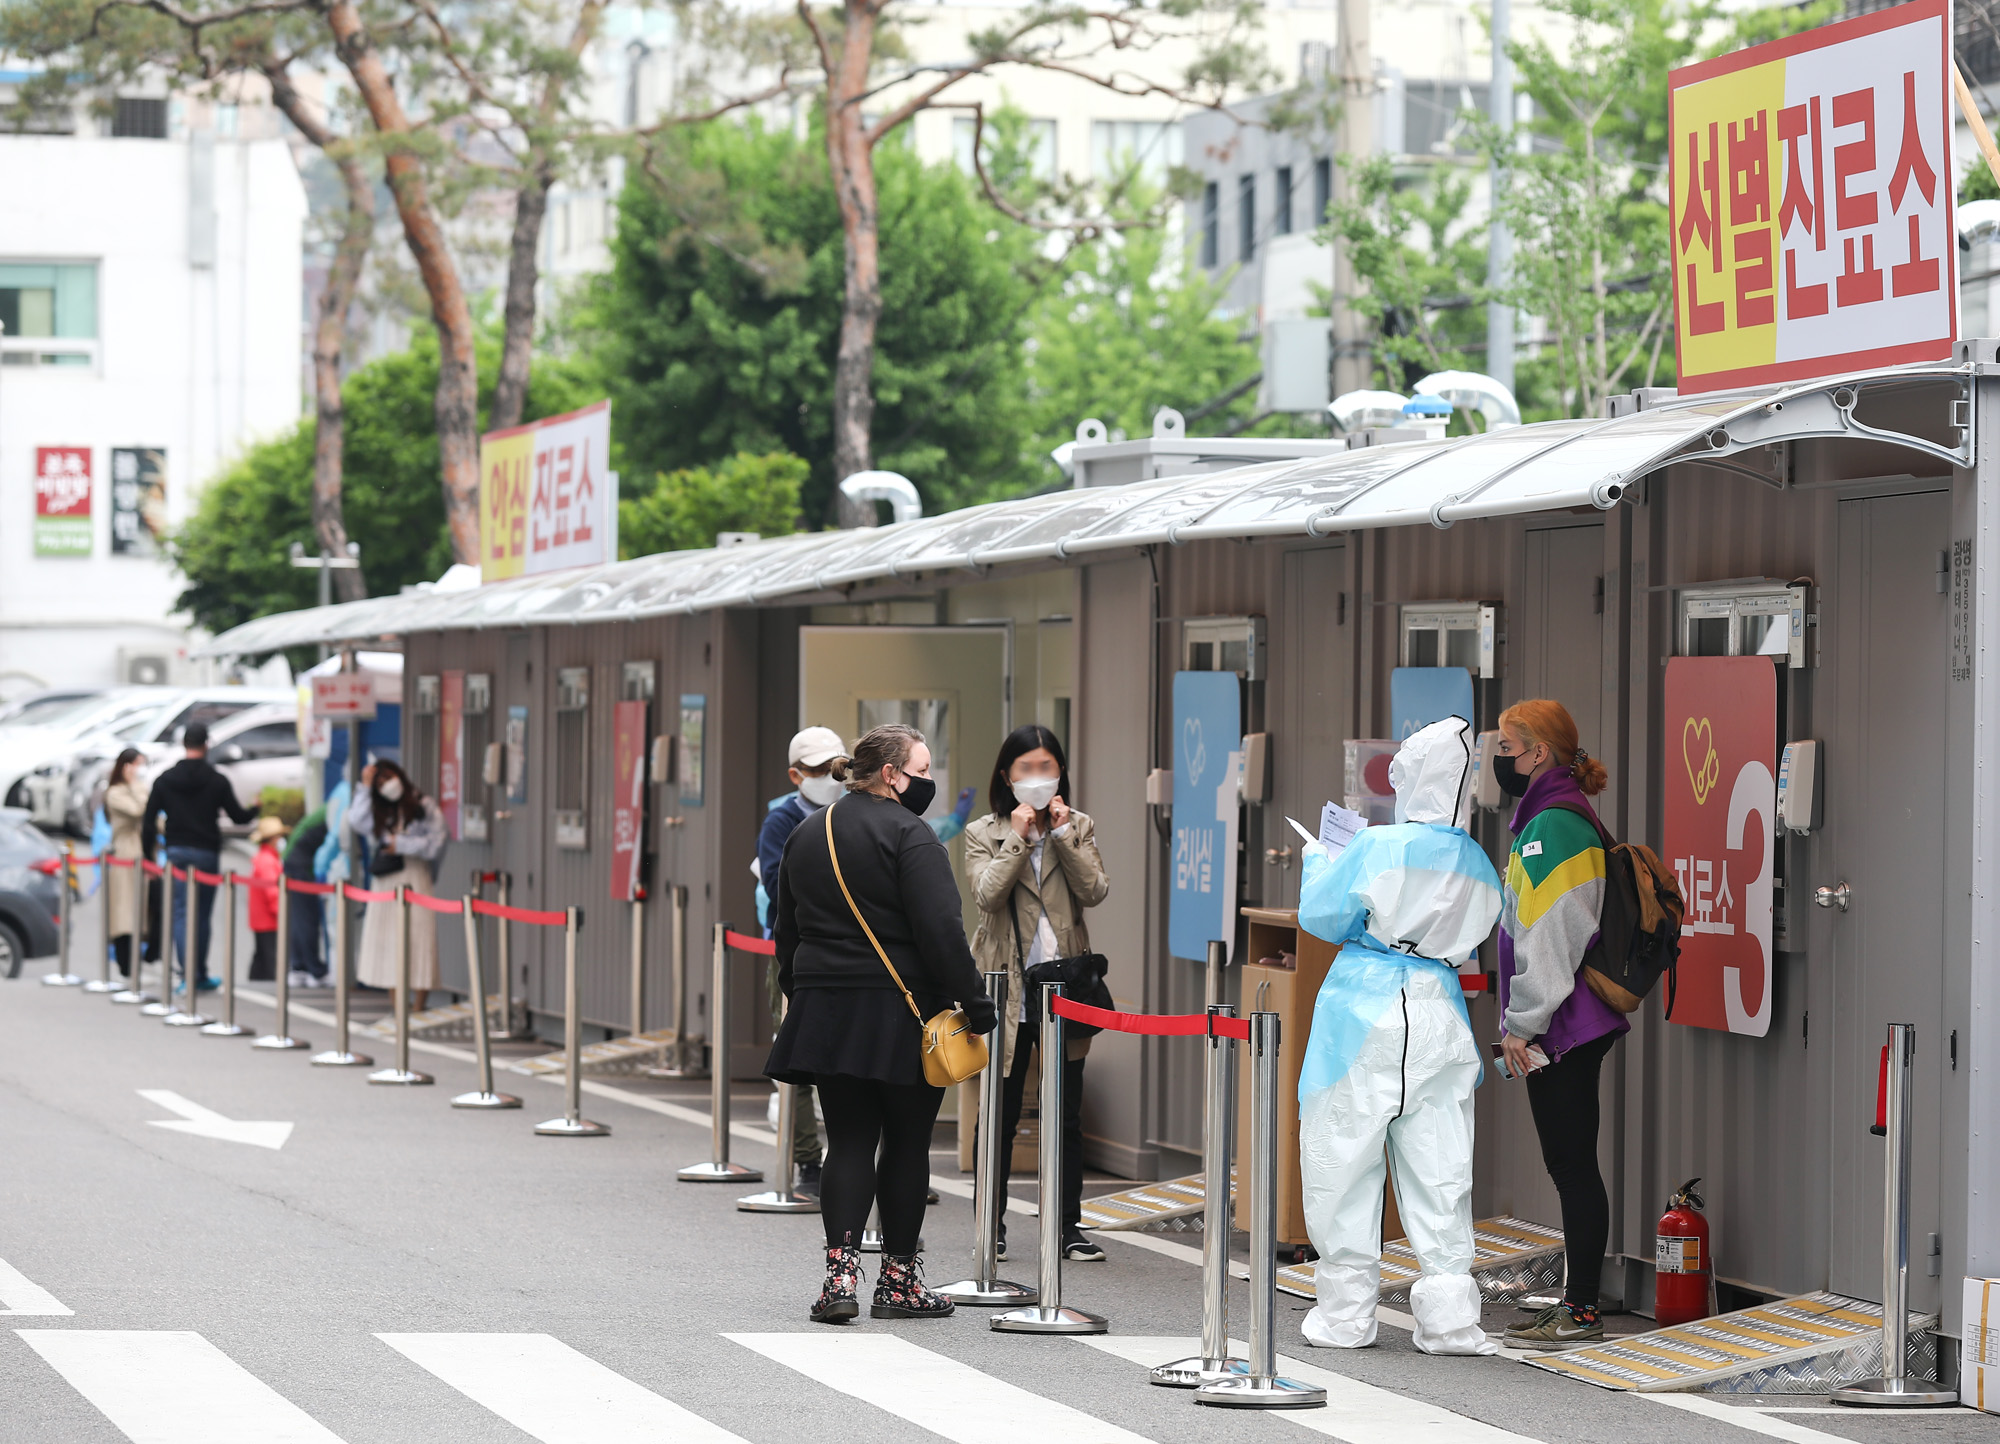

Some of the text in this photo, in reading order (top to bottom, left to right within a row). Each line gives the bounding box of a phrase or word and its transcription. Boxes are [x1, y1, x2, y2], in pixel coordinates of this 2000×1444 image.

[1678, 70, 1940, 337] 선별진료소
[490, 436, 594, 560] 안심진료소
[1176, 826, 1213, 893] 검사실
[1674, 855, 1735, 937] 진료소
[1725, 760, 1776, 1038] 3
